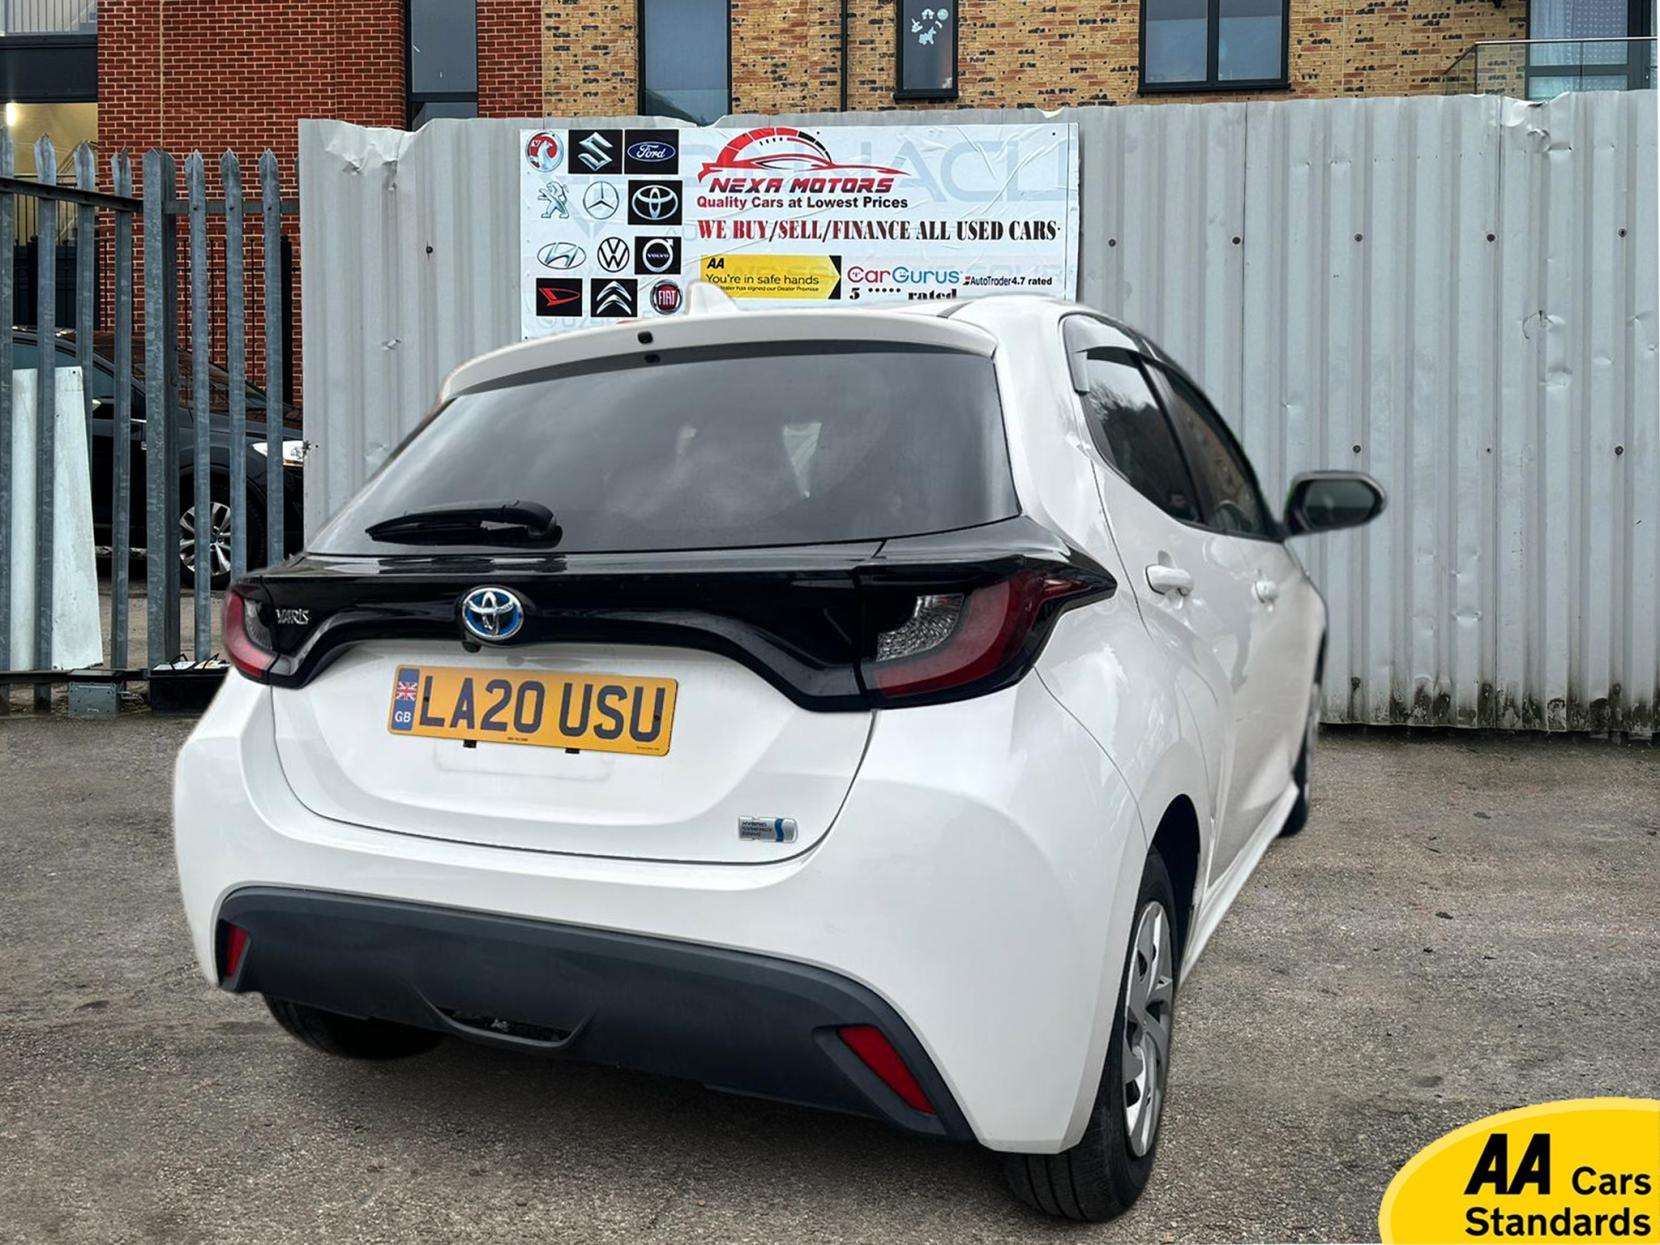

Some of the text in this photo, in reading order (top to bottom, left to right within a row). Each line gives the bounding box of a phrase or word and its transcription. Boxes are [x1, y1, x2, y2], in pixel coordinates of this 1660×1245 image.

[636, 145, 666, 159] Ford
[708, 177, 894, 194] NEXA MOTORS
[697, 196, 908, 210] Quality Cars at Lowest Prices
[698, 219, 727, 240] WE
[732, 219, 911, 242] BUY/SELL/FINANCE
[916, 219, 951, 241] ALL
[956, 220, 1004, 241] USED
[707, 257, 725, 269] AA
[706, 273, 820, 285] You're in safe hands
[847, 266, 960, 284] CarGurus
[970, 276, 1011, 286] AutoTrader
[1028, 277, 1053, 286] rated
[658, 289, 676, 306] FIAT
[849, 287, 957, 300] 5 rated
[419, 675, 666, 743] LA20 USU
[394, 710, 412, 724] GB
